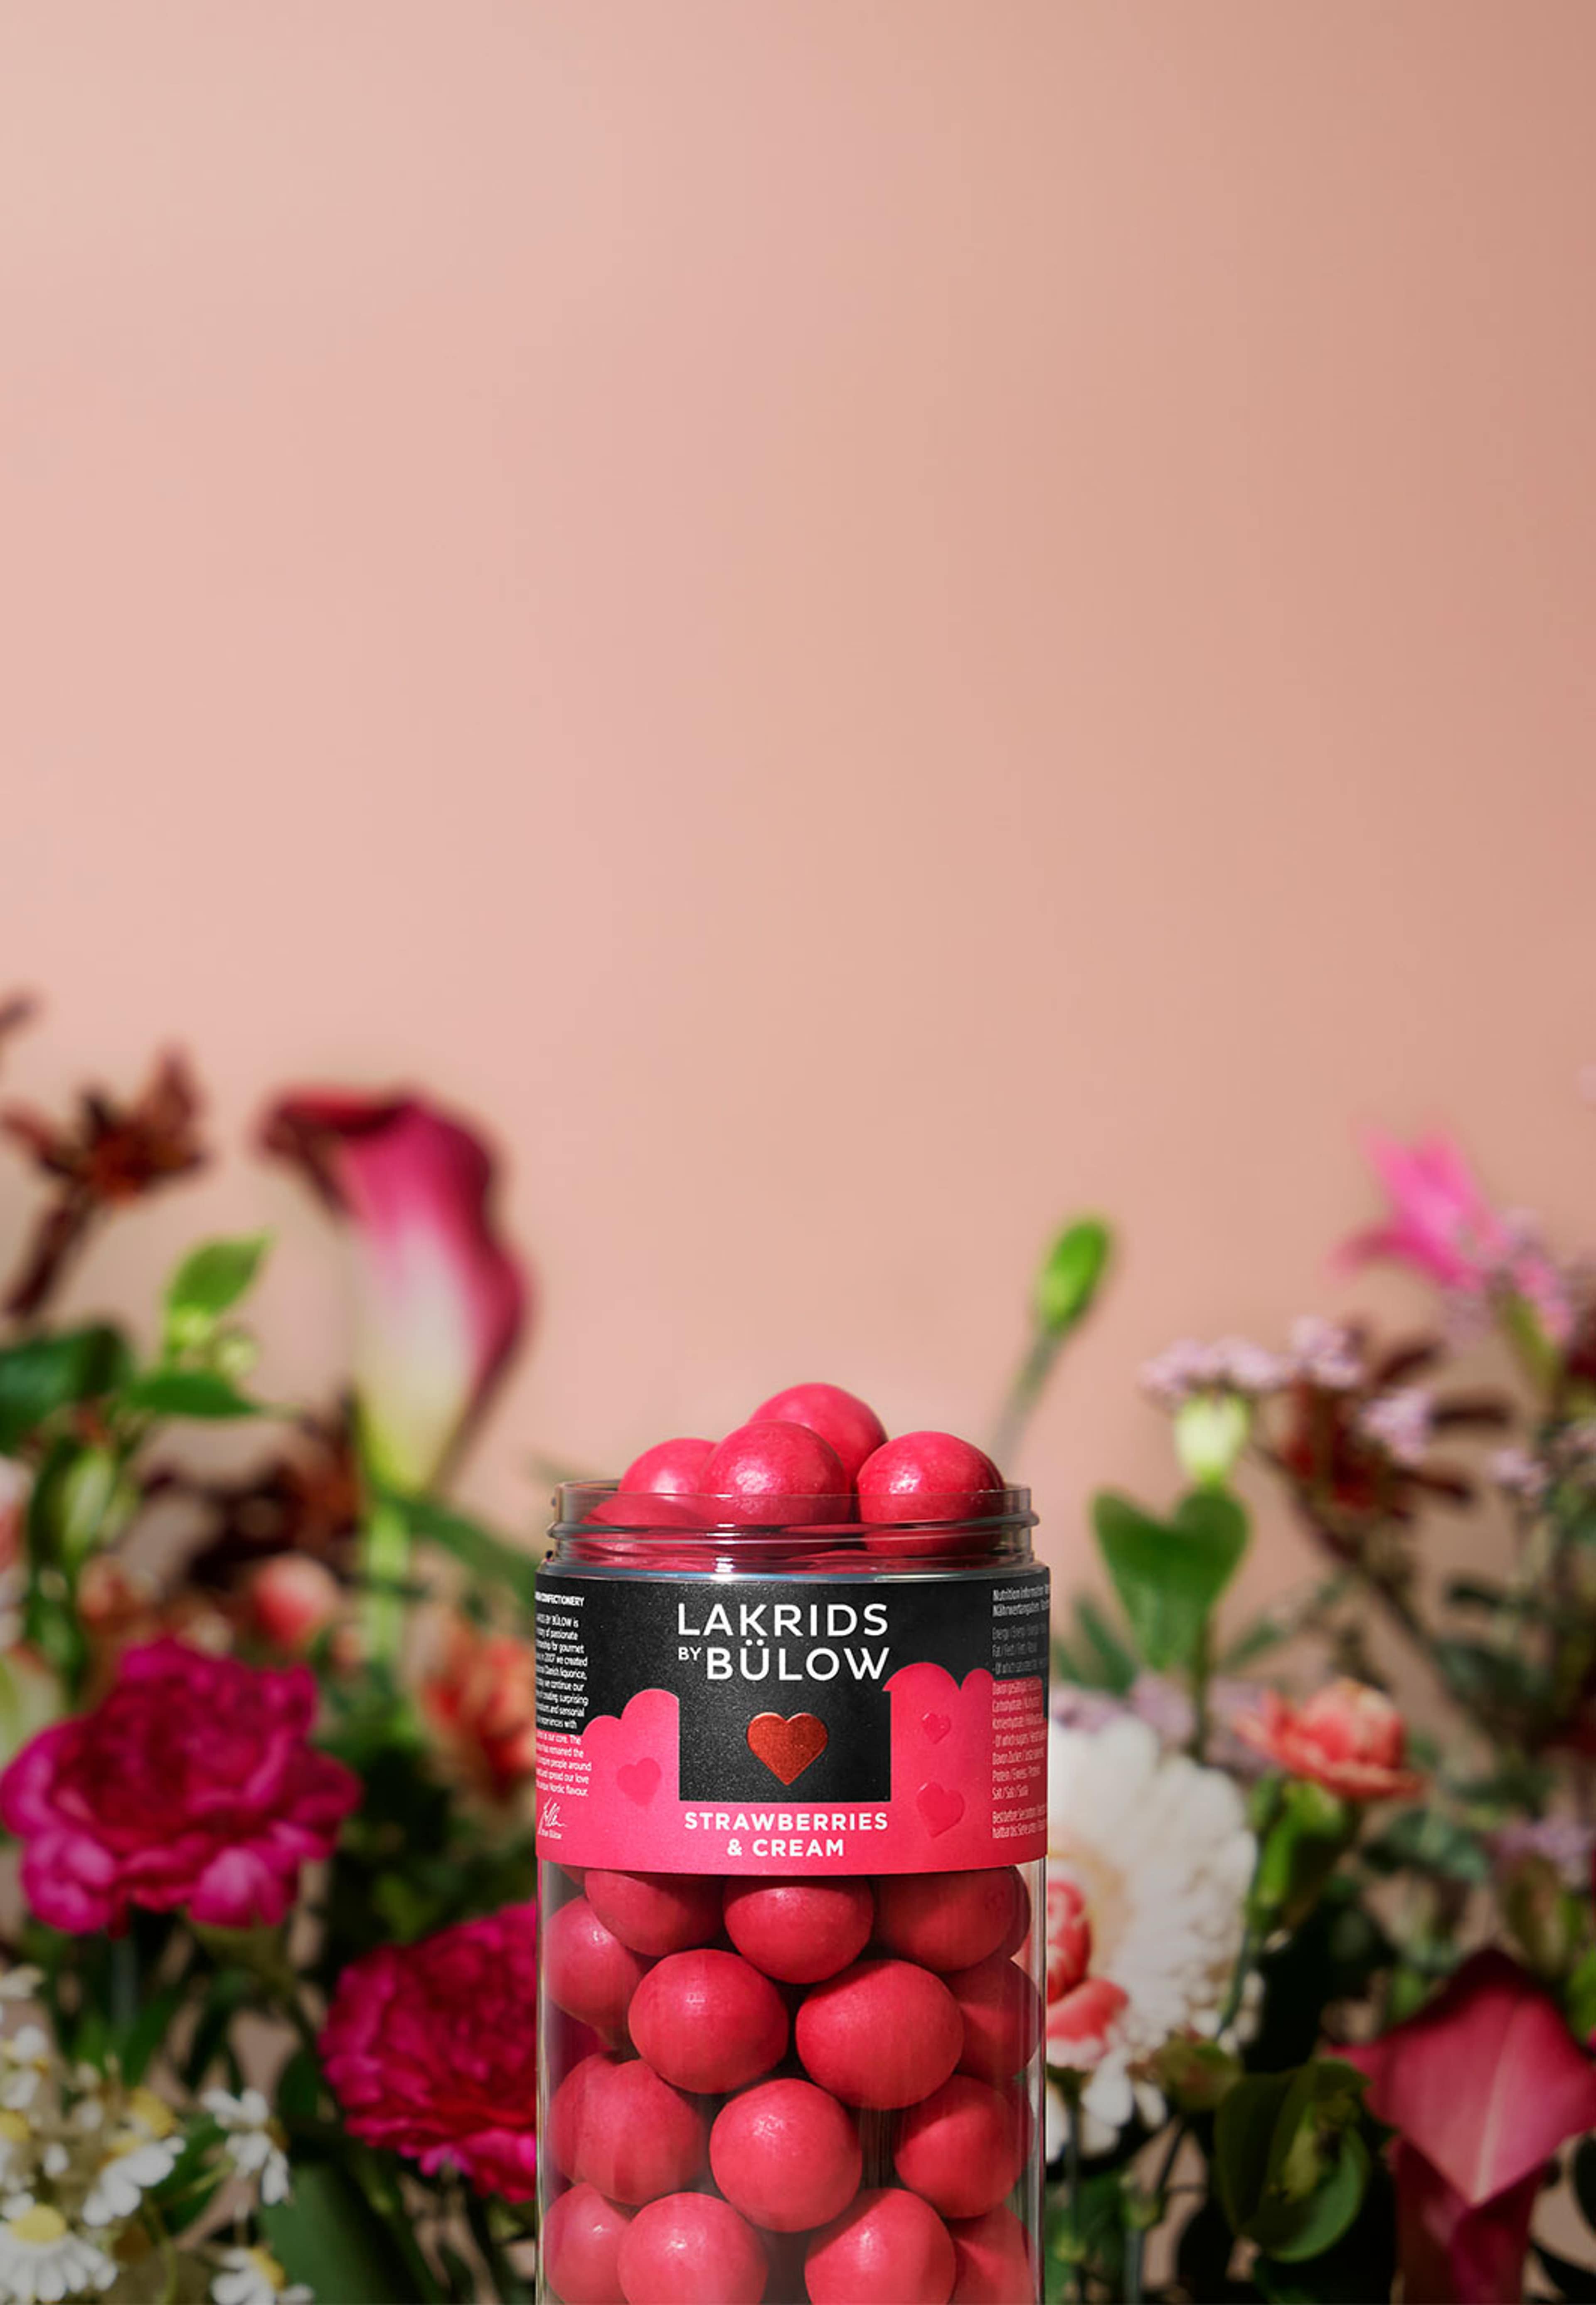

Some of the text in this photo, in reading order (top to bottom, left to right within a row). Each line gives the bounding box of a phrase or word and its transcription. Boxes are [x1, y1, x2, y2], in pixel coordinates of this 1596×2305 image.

[678, 1602, 889, 1637] LAKRIDS
[678, 1639, 890, 1681] BY BÜLOW
[573, 1683, 584, 1692] our
[573, 1747, 584, 1759] the
[575, 1773, 589, 1785] love
[684, 1812, 889, 1831] STRAWBERRIES
[727, 1838, 844, 1856] & CREAM
